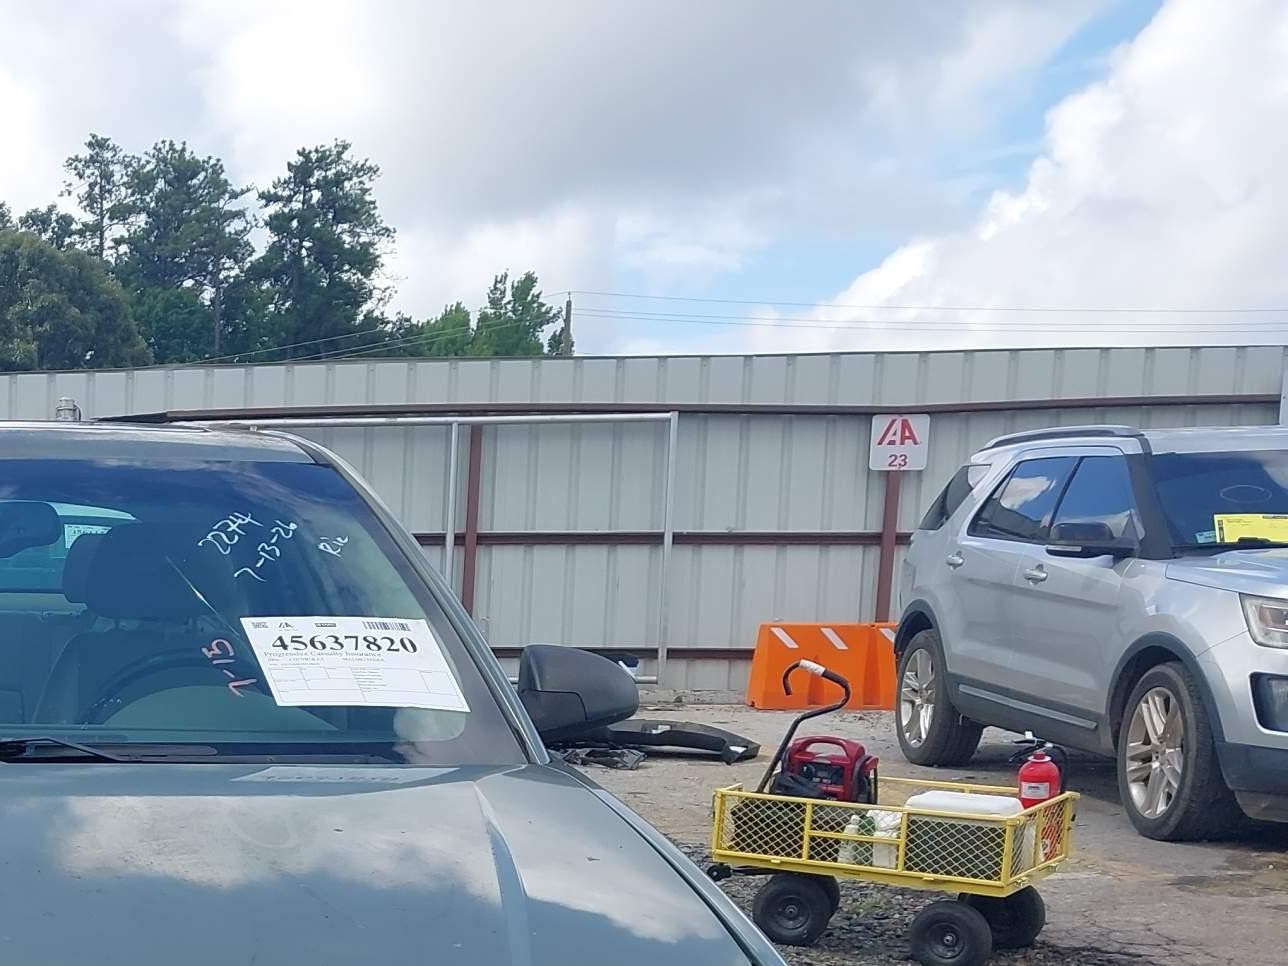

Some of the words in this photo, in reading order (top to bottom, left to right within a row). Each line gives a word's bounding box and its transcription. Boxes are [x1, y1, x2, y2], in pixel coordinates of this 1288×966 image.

[888, 453, 908, 468] 23
[234, 519, 297, 582] 7-13-26
[271, 634, 418, 654] 45637820
